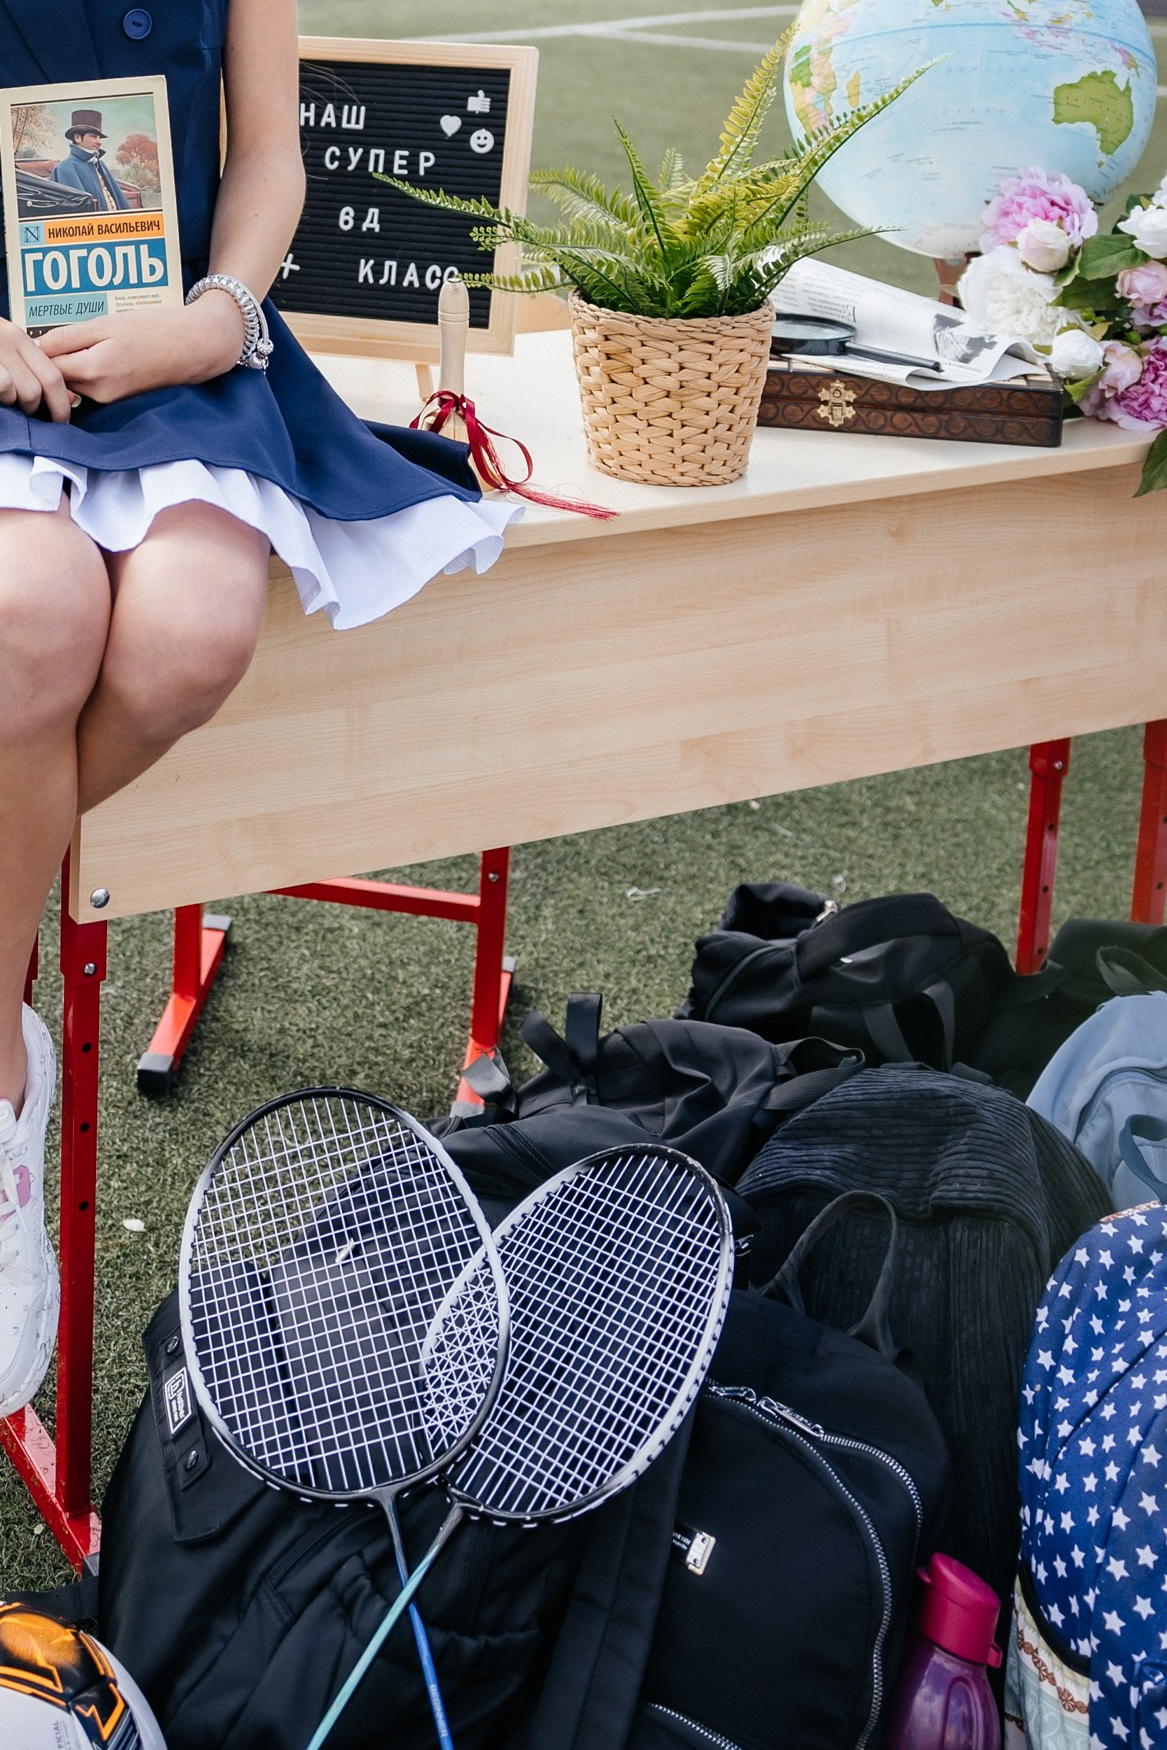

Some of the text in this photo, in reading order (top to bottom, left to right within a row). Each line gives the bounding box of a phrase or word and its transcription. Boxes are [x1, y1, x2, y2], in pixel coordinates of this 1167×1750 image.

[299, 103, 366, 130] НАШ
[324, 146, 435, 176] СУПЕР
[48, 220, 161, 239] НИКОЛАЙ ВАСИЛЬЕВИЧ
[338, 206, 381, 233] 6Д
[24, 244, 165, 292] ГОГОЛЬ
[29, 303, 74, 318] МЕРТВЫЕ
[75, 301, 105, 316] ДУШИ
[429, 1683, 448, 1738] BEGINNER
[53, 1720, 64, 1749] FICIAL
